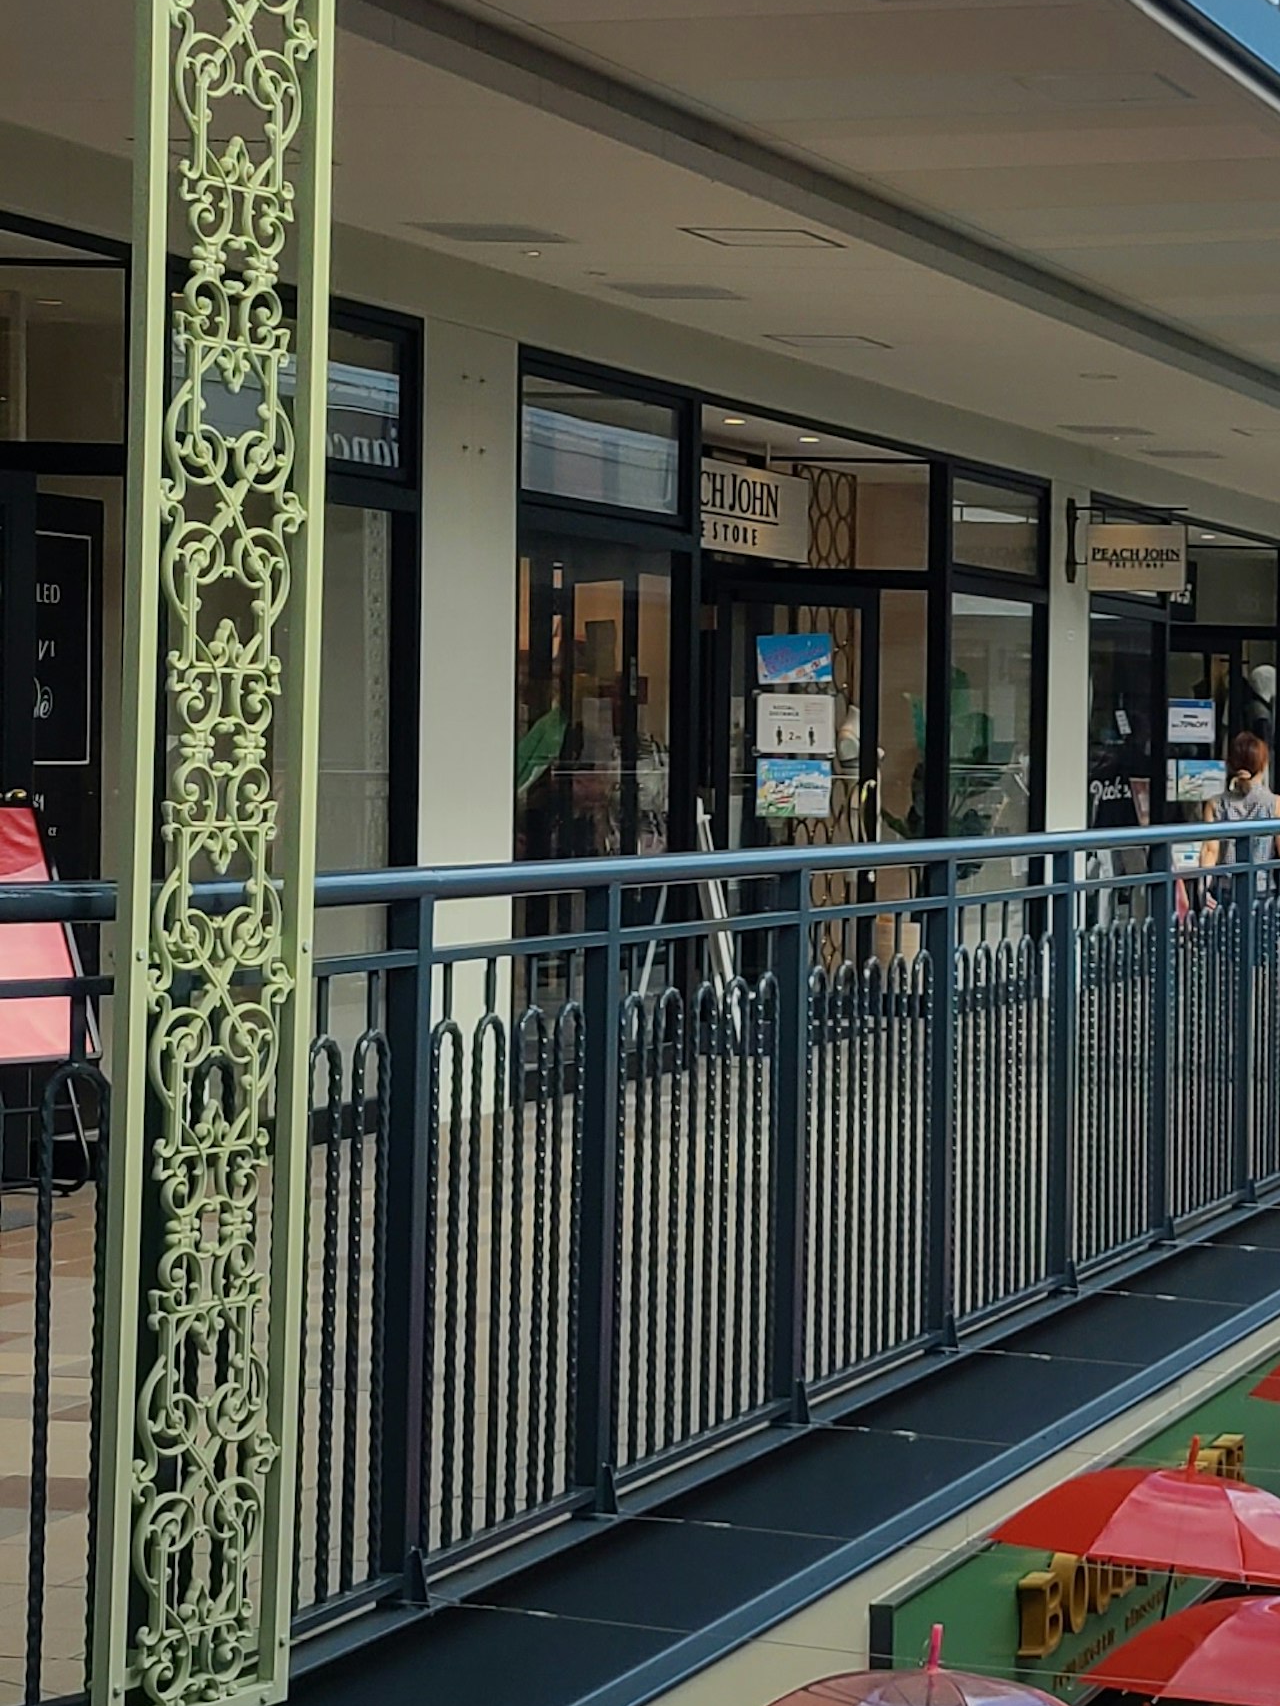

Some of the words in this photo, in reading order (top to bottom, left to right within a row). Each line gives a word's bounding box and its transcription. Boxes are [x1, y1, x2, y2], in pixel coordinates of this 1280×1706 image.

[729, 473, 779, 518] JOHN
[713, 522, 758, 547] STORE
[1092, 548, 1140, 561] PEACH
[1141, 548, 1180, 561] JOHN
